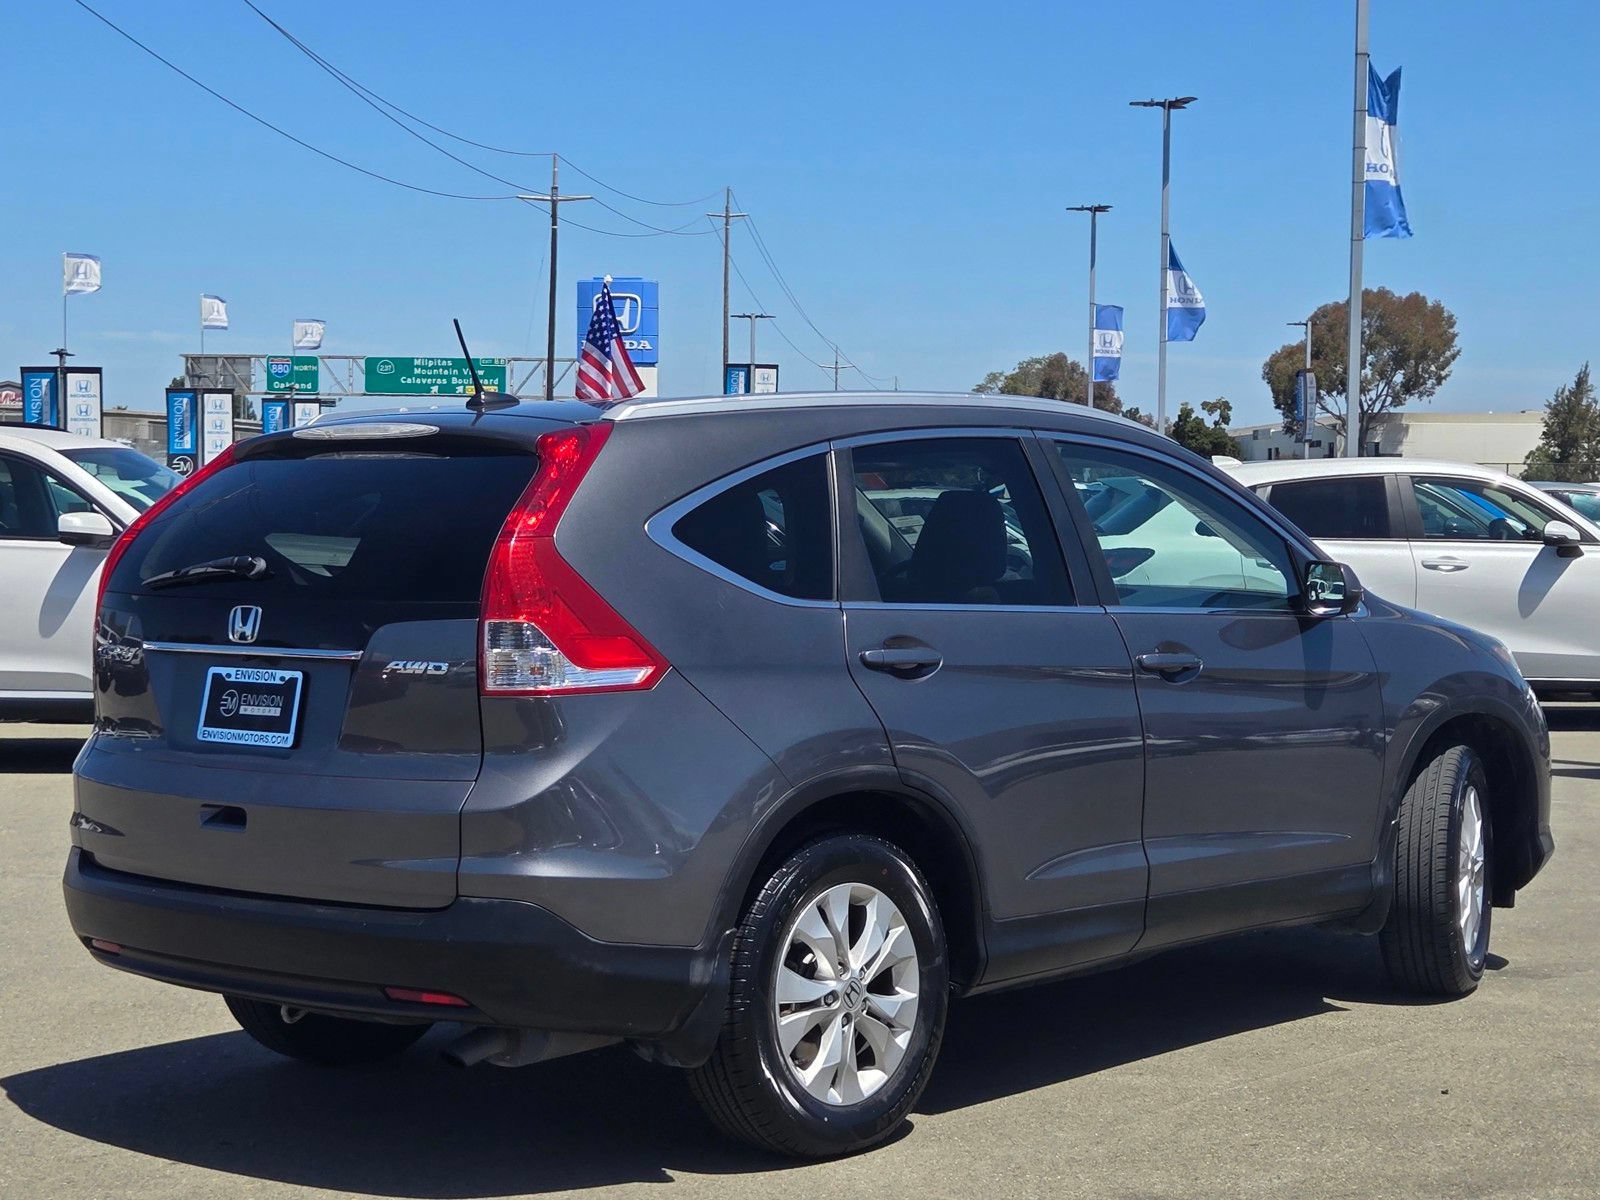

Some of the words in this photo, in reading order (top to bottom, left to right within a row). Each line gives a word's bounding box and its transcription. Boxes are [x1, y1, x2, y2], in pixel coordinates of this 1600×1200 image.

[413, 358, 453, 367] Milpitas
[272, 364, 289, 374] 880
[413, 367, 459, 375] Mountain
[462, 367, 485, 375] Viw
[400, 376, 448, 384] Calaveras
[451, 377, 499, 385] Boulvard
[382, 660, 449, 675] AWD
[234, 669, 277, 682] ENVISION
[240, 693, 285, 707] ENVISION
[202, 730, 289, 744] ENVISIONMOTORS.COM
